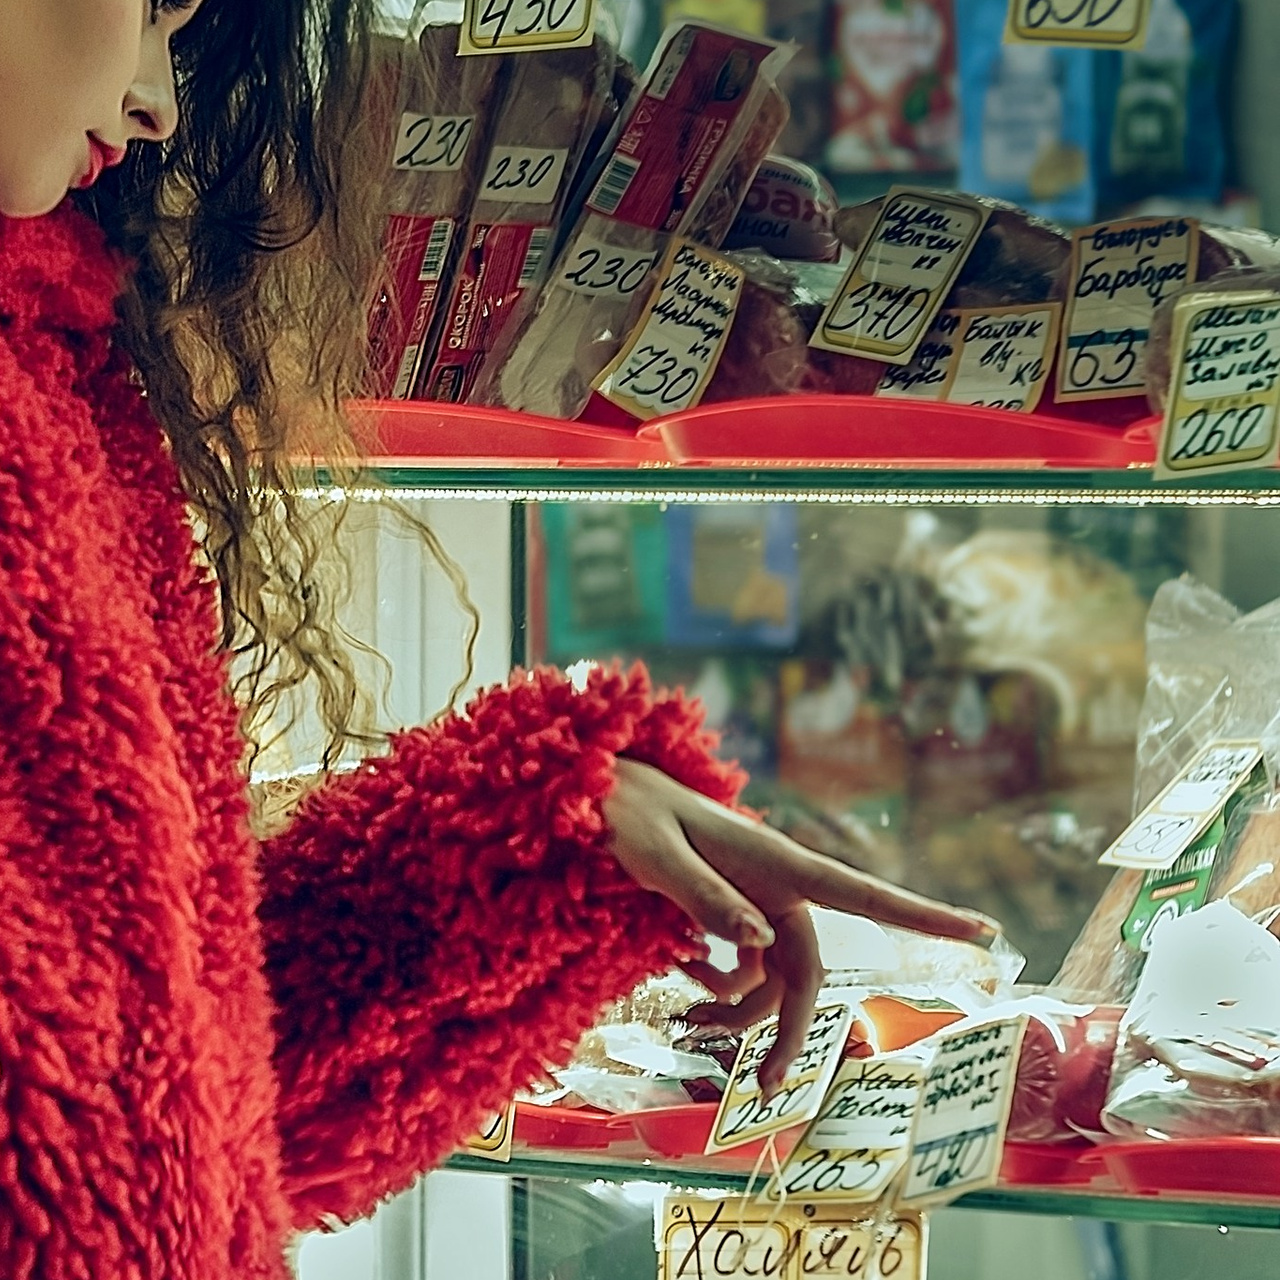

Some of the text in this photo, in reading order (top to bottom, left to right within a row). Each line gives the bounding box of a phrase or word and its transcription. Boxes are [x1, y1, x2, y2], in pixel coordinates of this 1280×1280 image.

[397, 117, 471, 167] 230
[486, 154, 556, 190] 230
[564, 248, 656, 294] 230
[448, 276, 476, 350] ОКОРОК
[617, 344, 699, 404] 730
[1070, 327, 1138, 389] 63
[1171, 404, 1266, 462] 260
